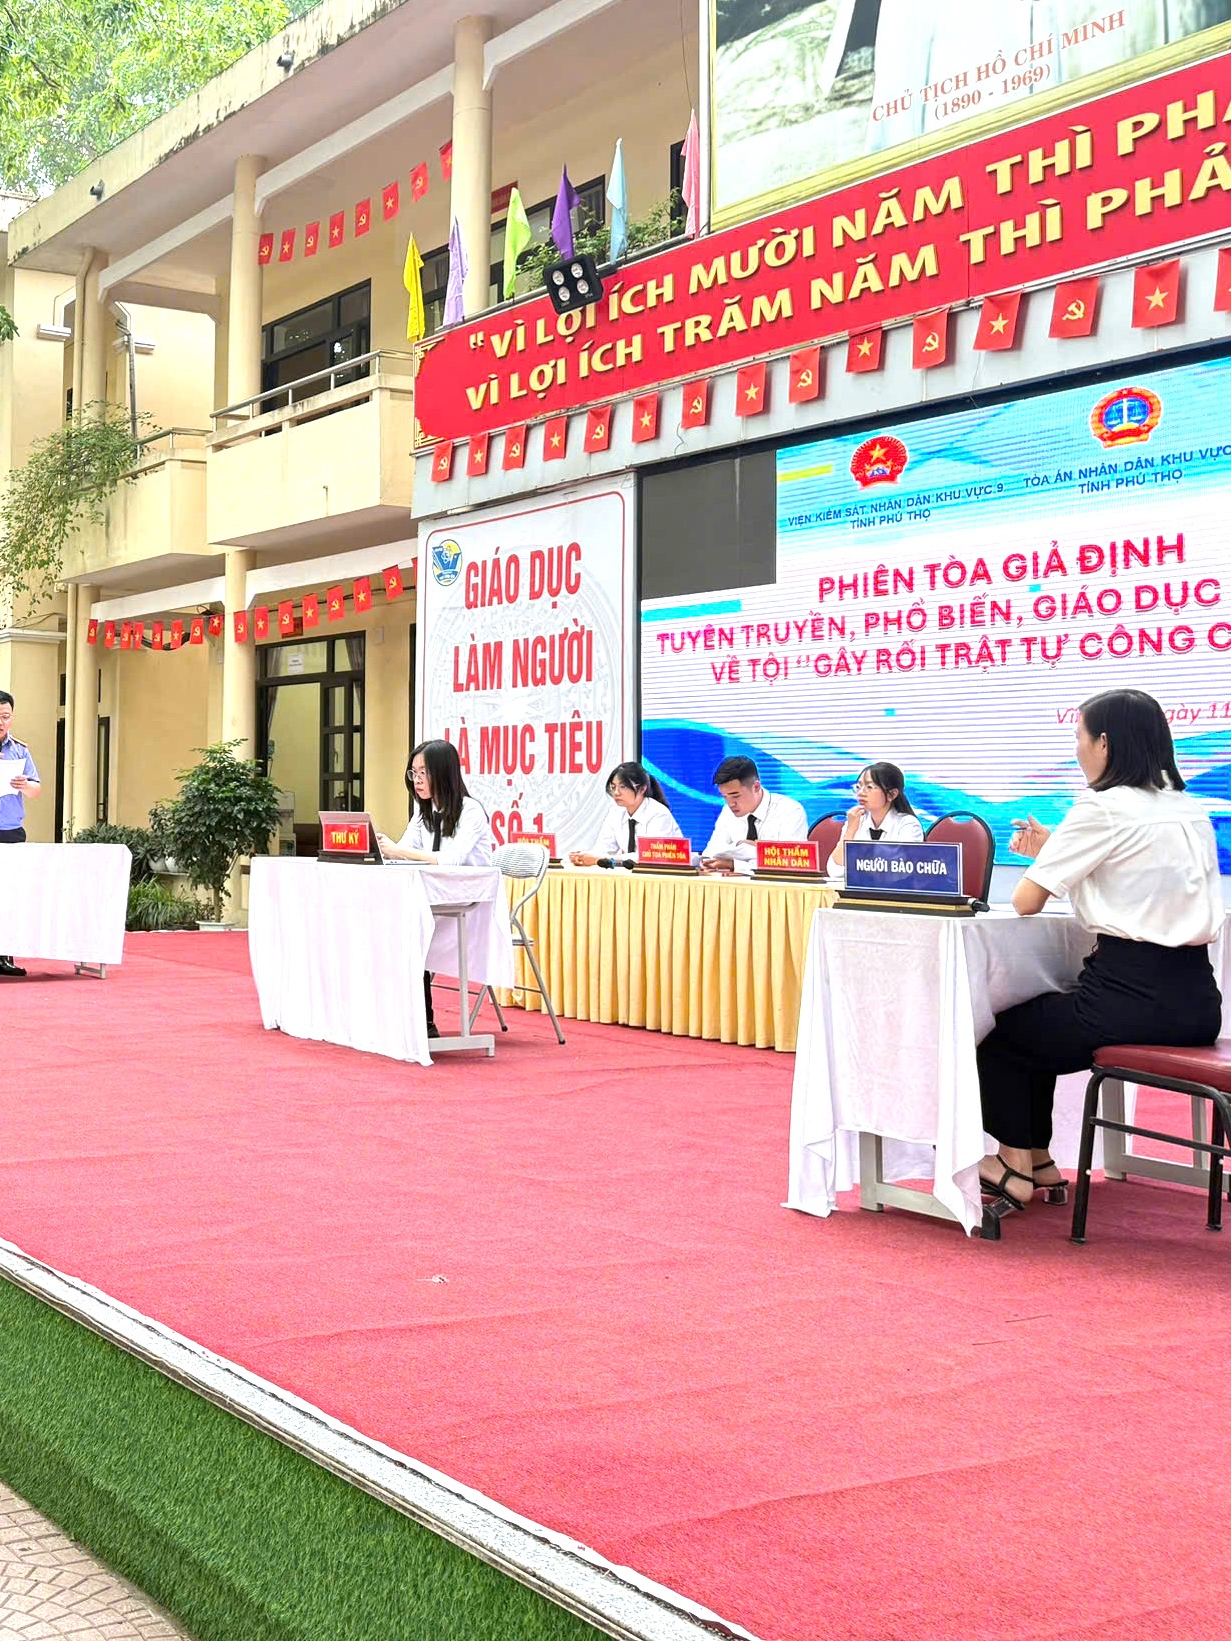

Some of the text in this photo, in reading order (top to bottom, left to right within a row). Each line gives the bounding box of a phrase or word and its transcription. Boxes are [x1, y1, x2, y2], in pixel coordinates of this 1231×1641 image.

[872, 9, 1125, 122] CHỦ TỊCH HỒ CHÍ MINH
[934, 89, 981, 120] (1890
[1001, 63, 1051, 94] 1969)
[536, 302, 597, 343] LỢI
[608, 273, 675, 322] ÍCH
[688, 225, 816, 295] MƯỜI
[832, 176, 965, 249] NĂM
[985, 124, 1094, 195] THÌ
[1117, 89, 1231, 157] PH
[466, 373, 501, 411] VÌ
[510, 357, 568, 400] LỢI
[578, 333, 644, 379] ÍCH
[657, 287, 794, 353] TRĂM
[810, 243, 939, 310] NĂM
[959, 198, 1063, 265] THÌ
[1023, 471, 1049, 488] TÒA
[1054, 468, 1073, 483] ÁN
[1078, 462, 1118, 480] NHÂN
[1124, 456, 1155, 472] DÂN
[1161, 450, 1194, 466] KHU
[1115, 471, 1146, 489] PHÚ
[1152, 469, 1183, 484] THỌ
[788, 514, 812, 528] VIỆN
[845, 504, 866, 517] SÁT
[870, 497, 902, 515] NHÂN
[907, 493, 931, 508] DÂN
[936, 488, 961, 503] KHU
[965, 484, 993, 501] VỰC
[997, 483, 1004, 493] 9
[879, 511, 903, 526] PHÚ
[908, 508, 931, 523] THỌ
[465, 541, 582, 610] GIÁO DỤC
[819, 532, 1185, 603] PHIÊN TÒA GIẢ ĐỊNH
[656, 624, 735, 655] TUYÊN
[864, 597, 928, 637] PHỔ
[938, 592, 1023, 631] BIẾN,
[1033, 584, 1122, 621] GIÁO
[1134, 578, 1221, 615] DỤC
[453, 618, 593, 692] LÀM NGƯỜI
[710, 654, 740, 684] VỀ
[748, 652, 789, 686] TỘI
[876, 639, 926, 673] RỐI
[935, 634, 1012, 669] TRẬT
[1020, 633, 1069, 670] TỰ
[1079, 623, 1196, 660] CÔNG
[480, 723, 535, 786] MỤC
[545, 710, 603, 774] TIÊU
[349, 829, 359, 844] KÝ
[764, 845, 809, 857] HỘI THẨM
[764, 857, 809, 867] NHÂN DÂN
[856, 857, 947, 875] NGƯỜI BÀO CHỮA
